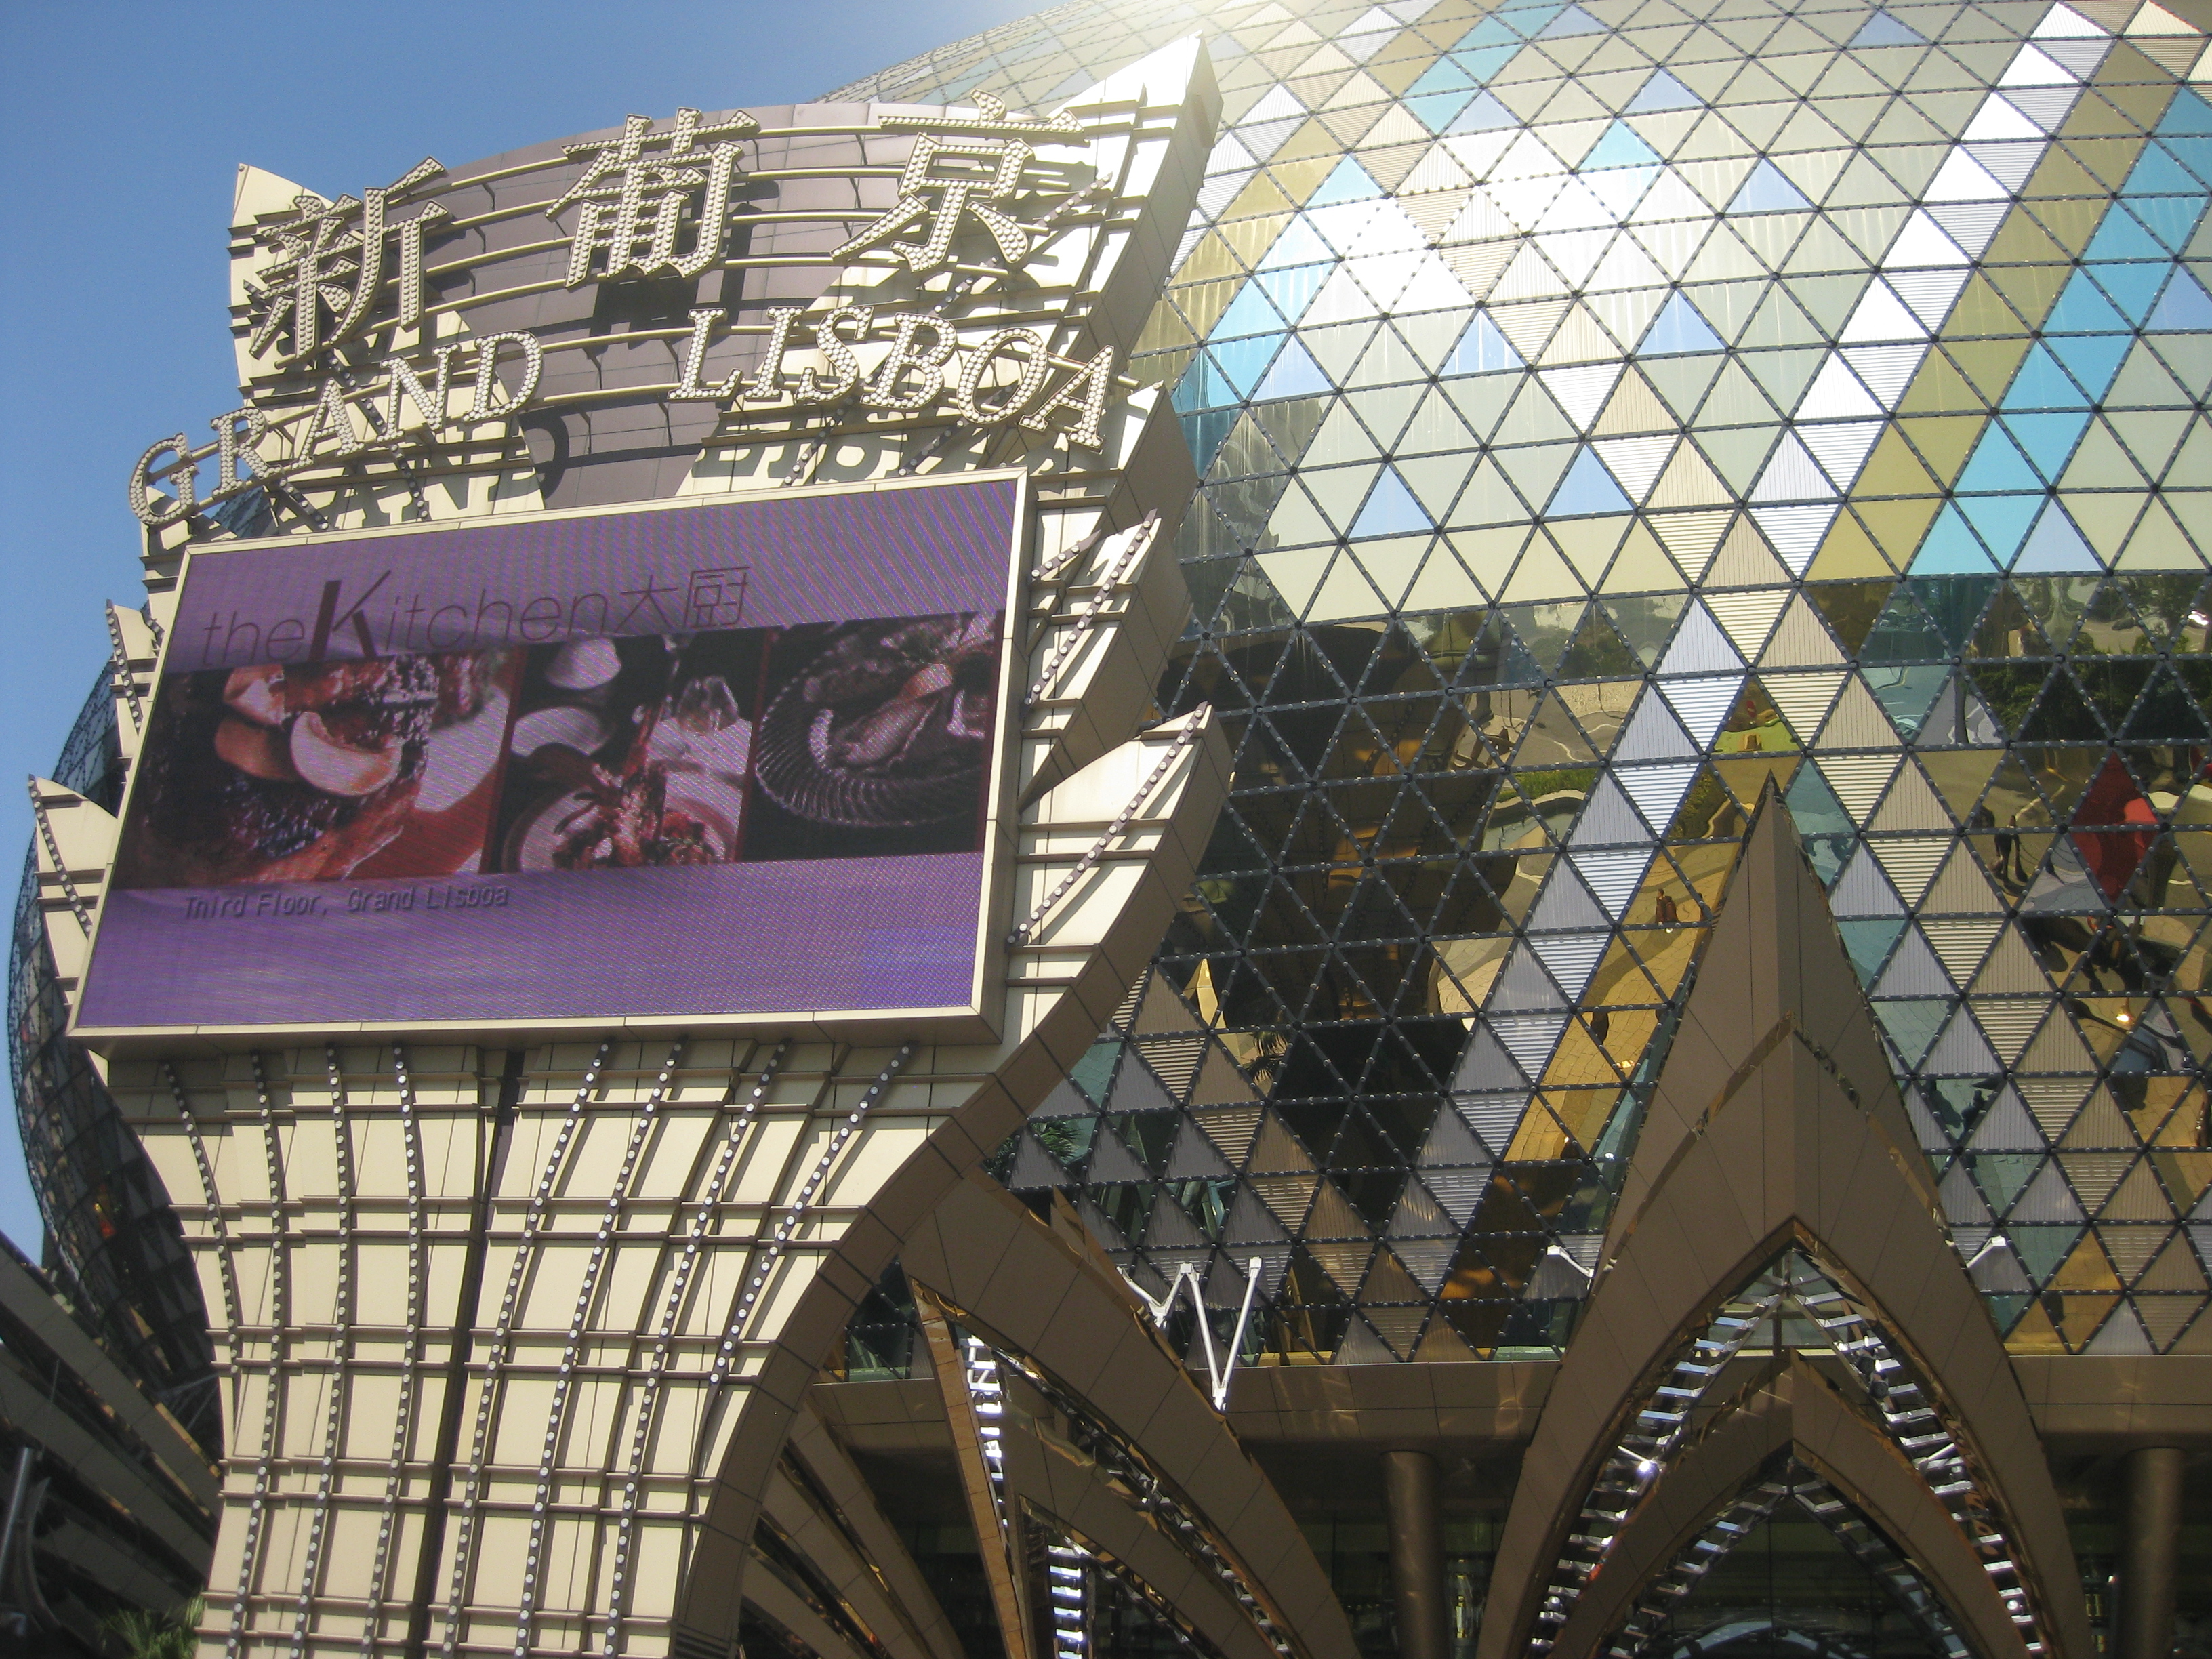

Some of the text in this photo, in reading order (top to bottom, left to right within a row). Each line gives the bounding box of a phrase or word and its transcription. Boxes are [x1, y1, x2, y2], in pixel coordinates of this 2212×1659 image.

[248, 89, 1085, 360] 新葡京
[129, 304, 1115, 525] GRAND LISBOA
[184, 884, 510, 920] Third Floor, Grand Lisboa
